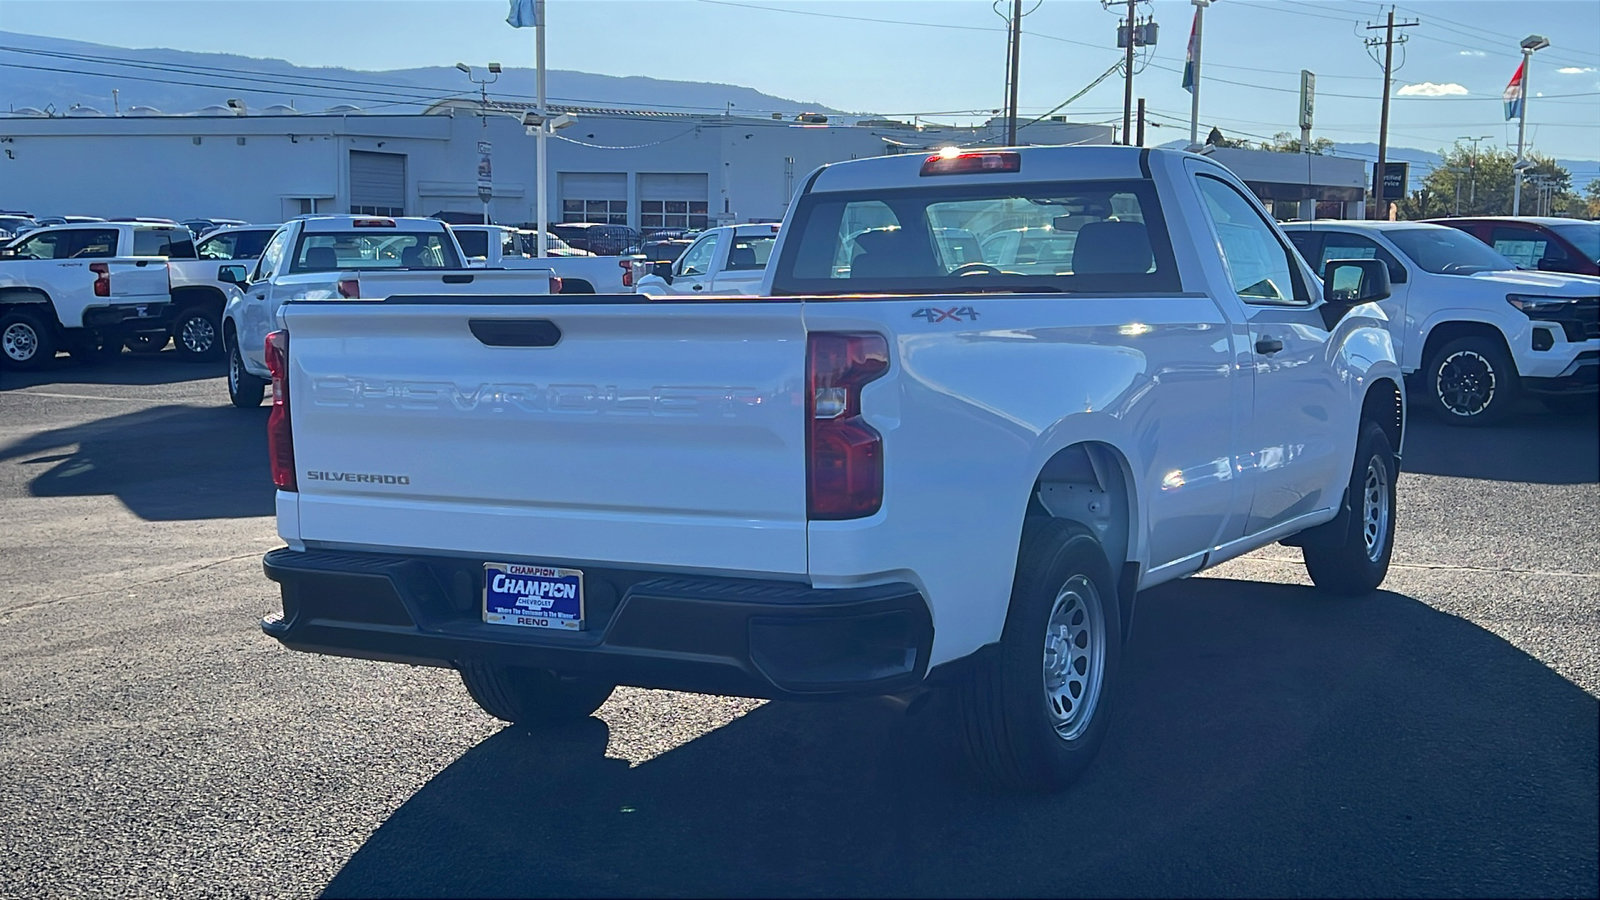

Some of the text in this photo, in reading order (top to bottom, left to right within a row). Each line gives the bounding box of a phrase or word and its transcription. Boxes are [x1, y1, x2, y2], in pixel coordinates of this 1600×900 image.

[312, 375, 758, 419] CHEVROLET
[307, 470, 410, 485] SILVERADO
[509, 565, 555, 577] CHAMPION
[492, 574, 576, 599] CHAMPION
[518, 598, 552, 606] CHEVROLET
[517, 617, 549, 627] RENO
